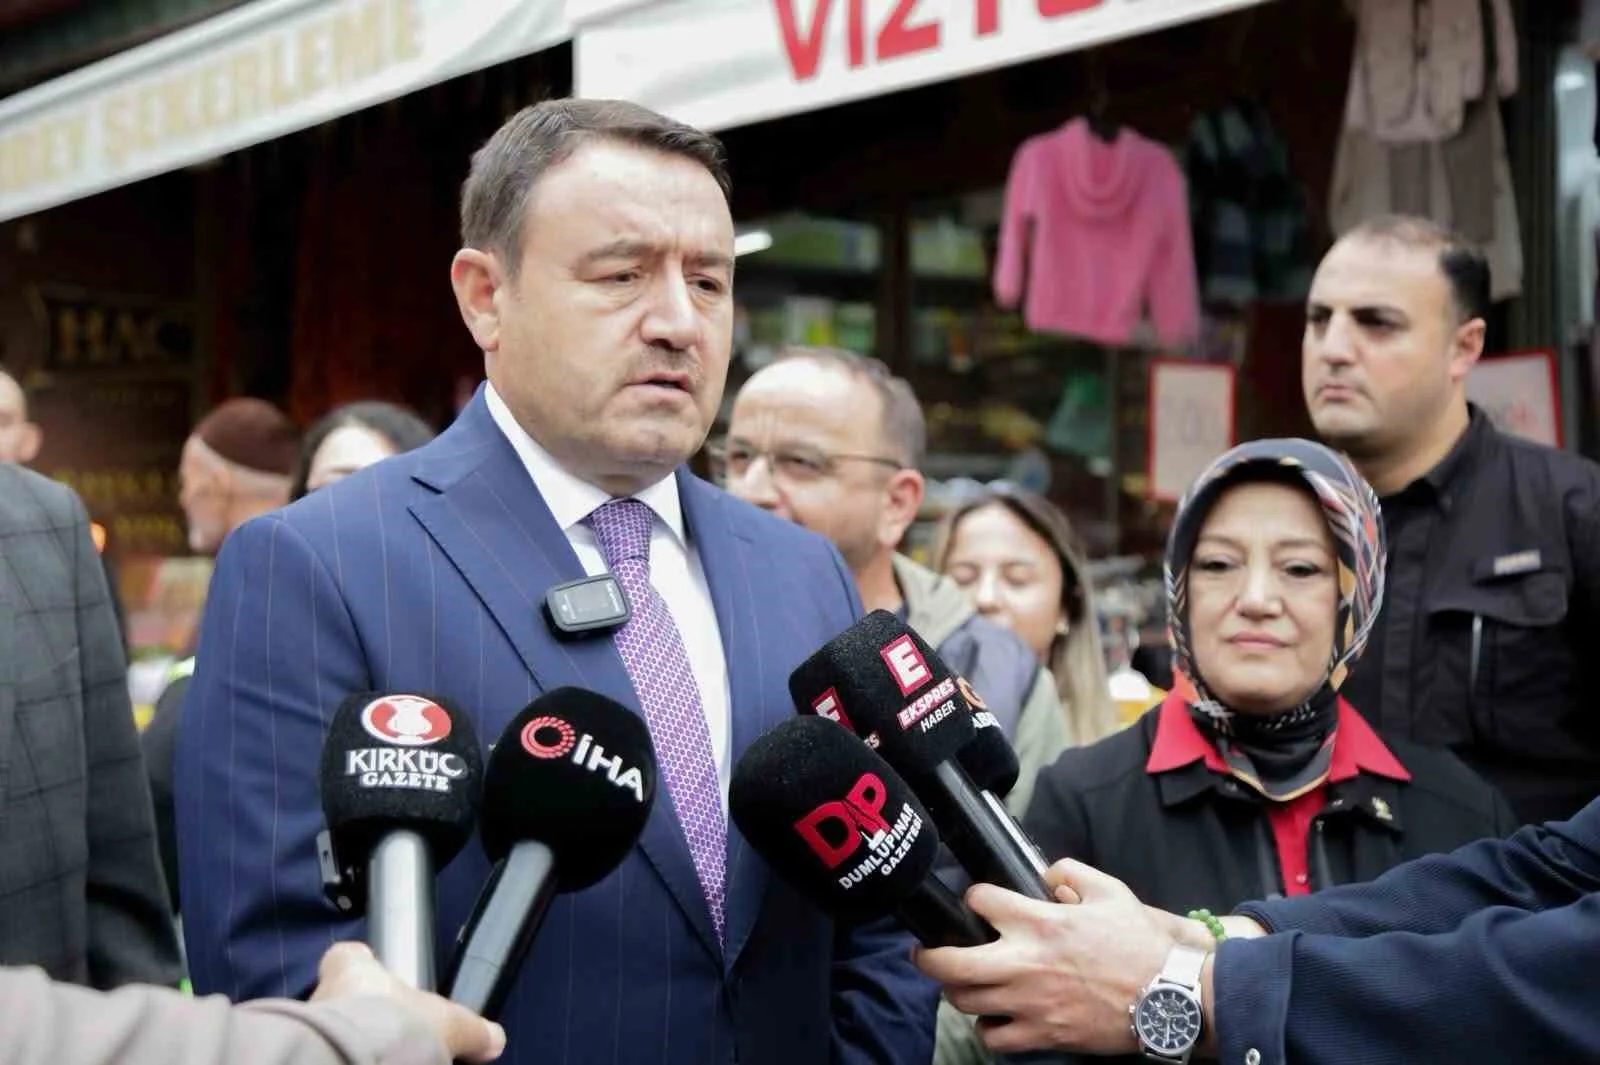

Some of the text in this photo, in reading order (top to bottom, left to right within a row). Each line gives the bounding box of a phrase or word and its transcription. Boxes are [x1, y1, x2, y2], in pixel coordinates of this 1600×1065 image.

[887, 641, 928, 689] E
[899, 677, 957, 728] EKSPRES
[920, 699, 956, 732] HABER
[360, 771, 451, 791] GAZETE
[838, 801, 915, 890] DUMLUPINAR
